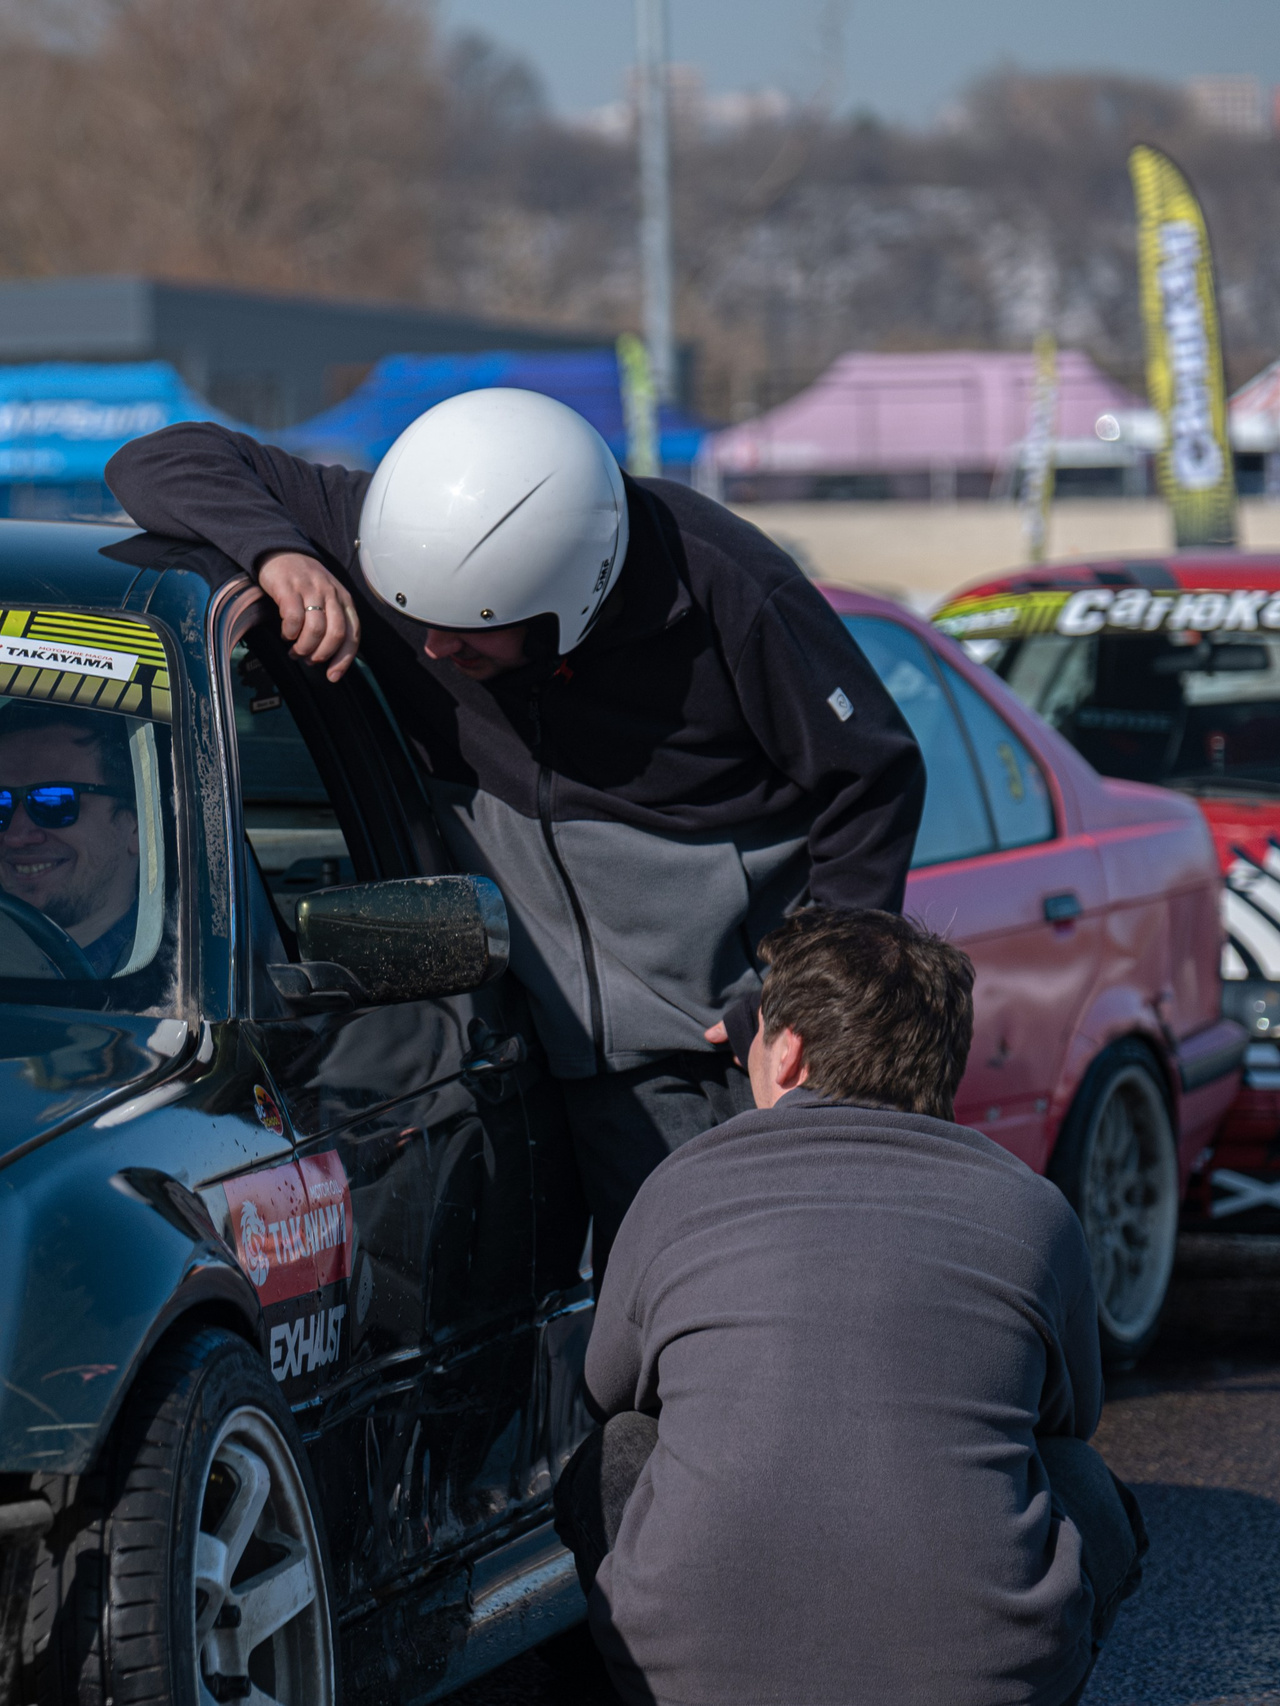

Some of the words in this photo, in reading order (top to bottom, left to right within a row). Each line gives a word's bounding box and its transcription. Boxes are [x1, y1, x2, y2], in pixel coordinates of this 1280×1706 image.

[6, 647, 114, 670] TAKAYAMA
[38, 646, 84, 656] МОТОРНЫЕ
[85, 653, 113, 661] МАСЛА
[309, 1182, 330, 1199] MOTOR
[329, 1179, 343, 1195] OIL
[268, 1202, 347, 1264] TAKAYAMA
[270, 1304, 346, 1382] EXHAUST
